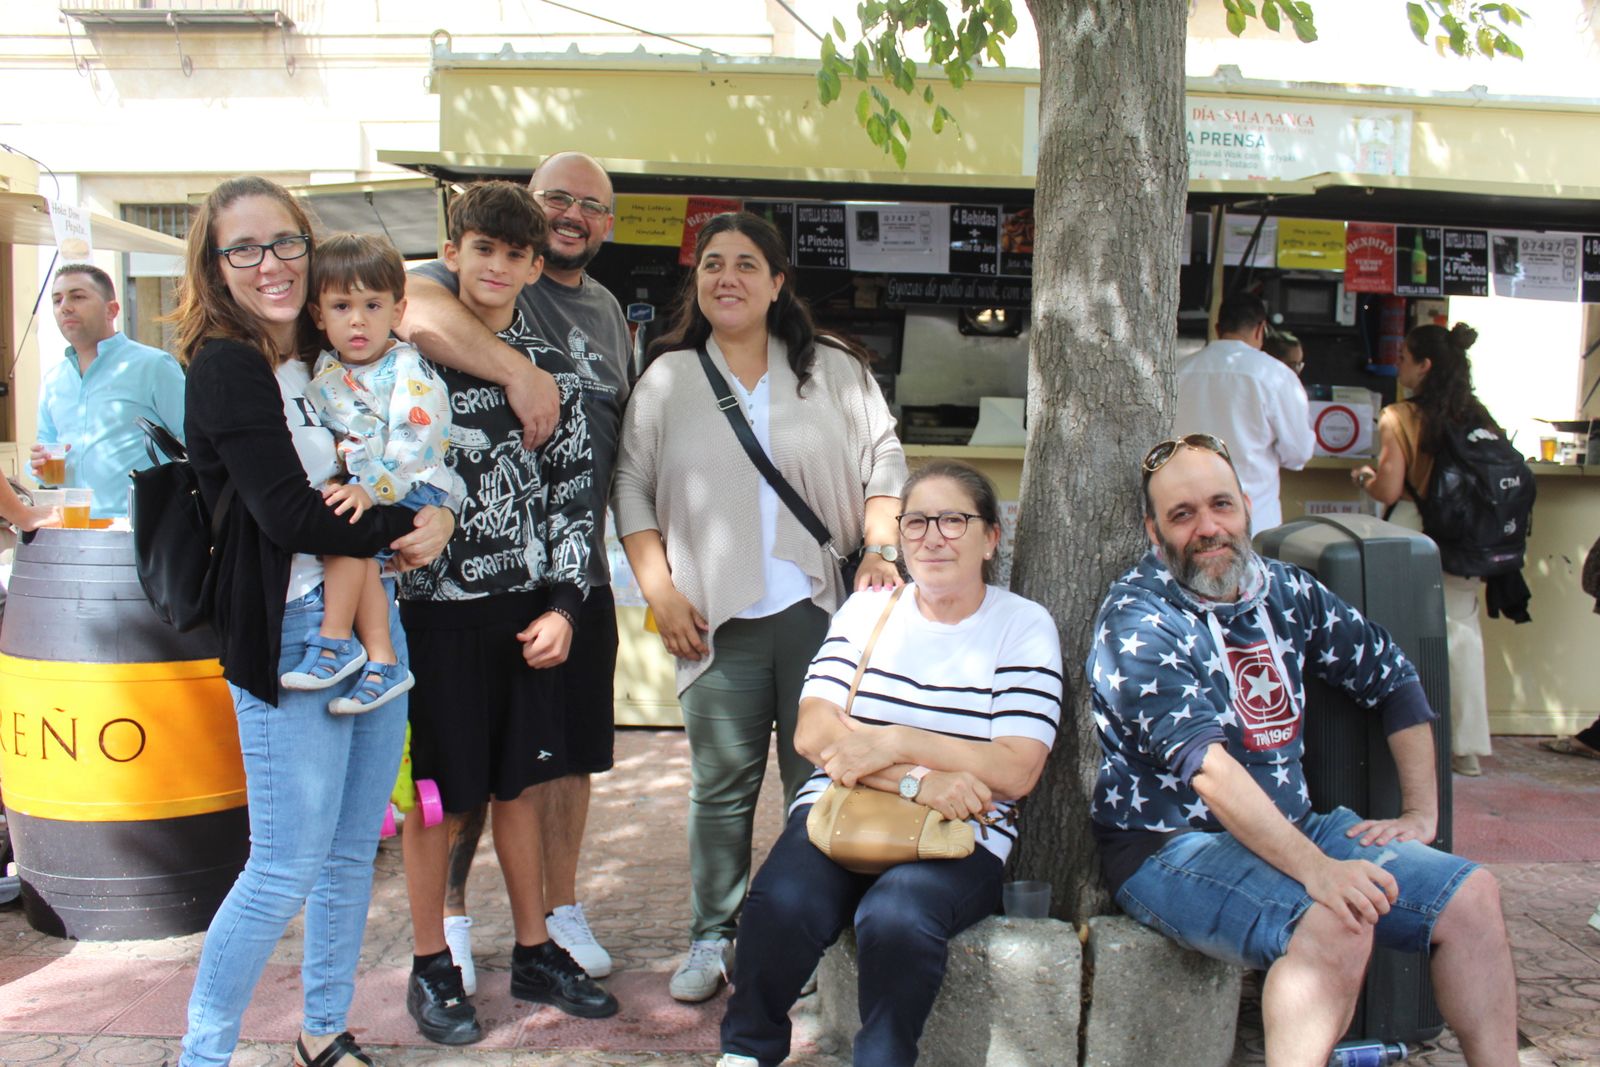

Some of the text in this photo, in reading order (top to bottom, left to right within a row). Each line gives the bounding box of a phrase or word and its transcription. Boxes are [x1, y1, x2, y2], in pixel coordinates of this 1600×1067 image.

[1200, 131, 1266, 148] PRENSA
[952, 207, 997, 227] 4 Bebidas
[799, 234, 845, 248] 4 Pinchos
[1346, 236, 1394, 255] BENDITO
[1521, 240, 1561, 252] 07427
[1584, 239, 1591, 254] 4
[1444, 261, 1487, 276] 4 Pinchos
